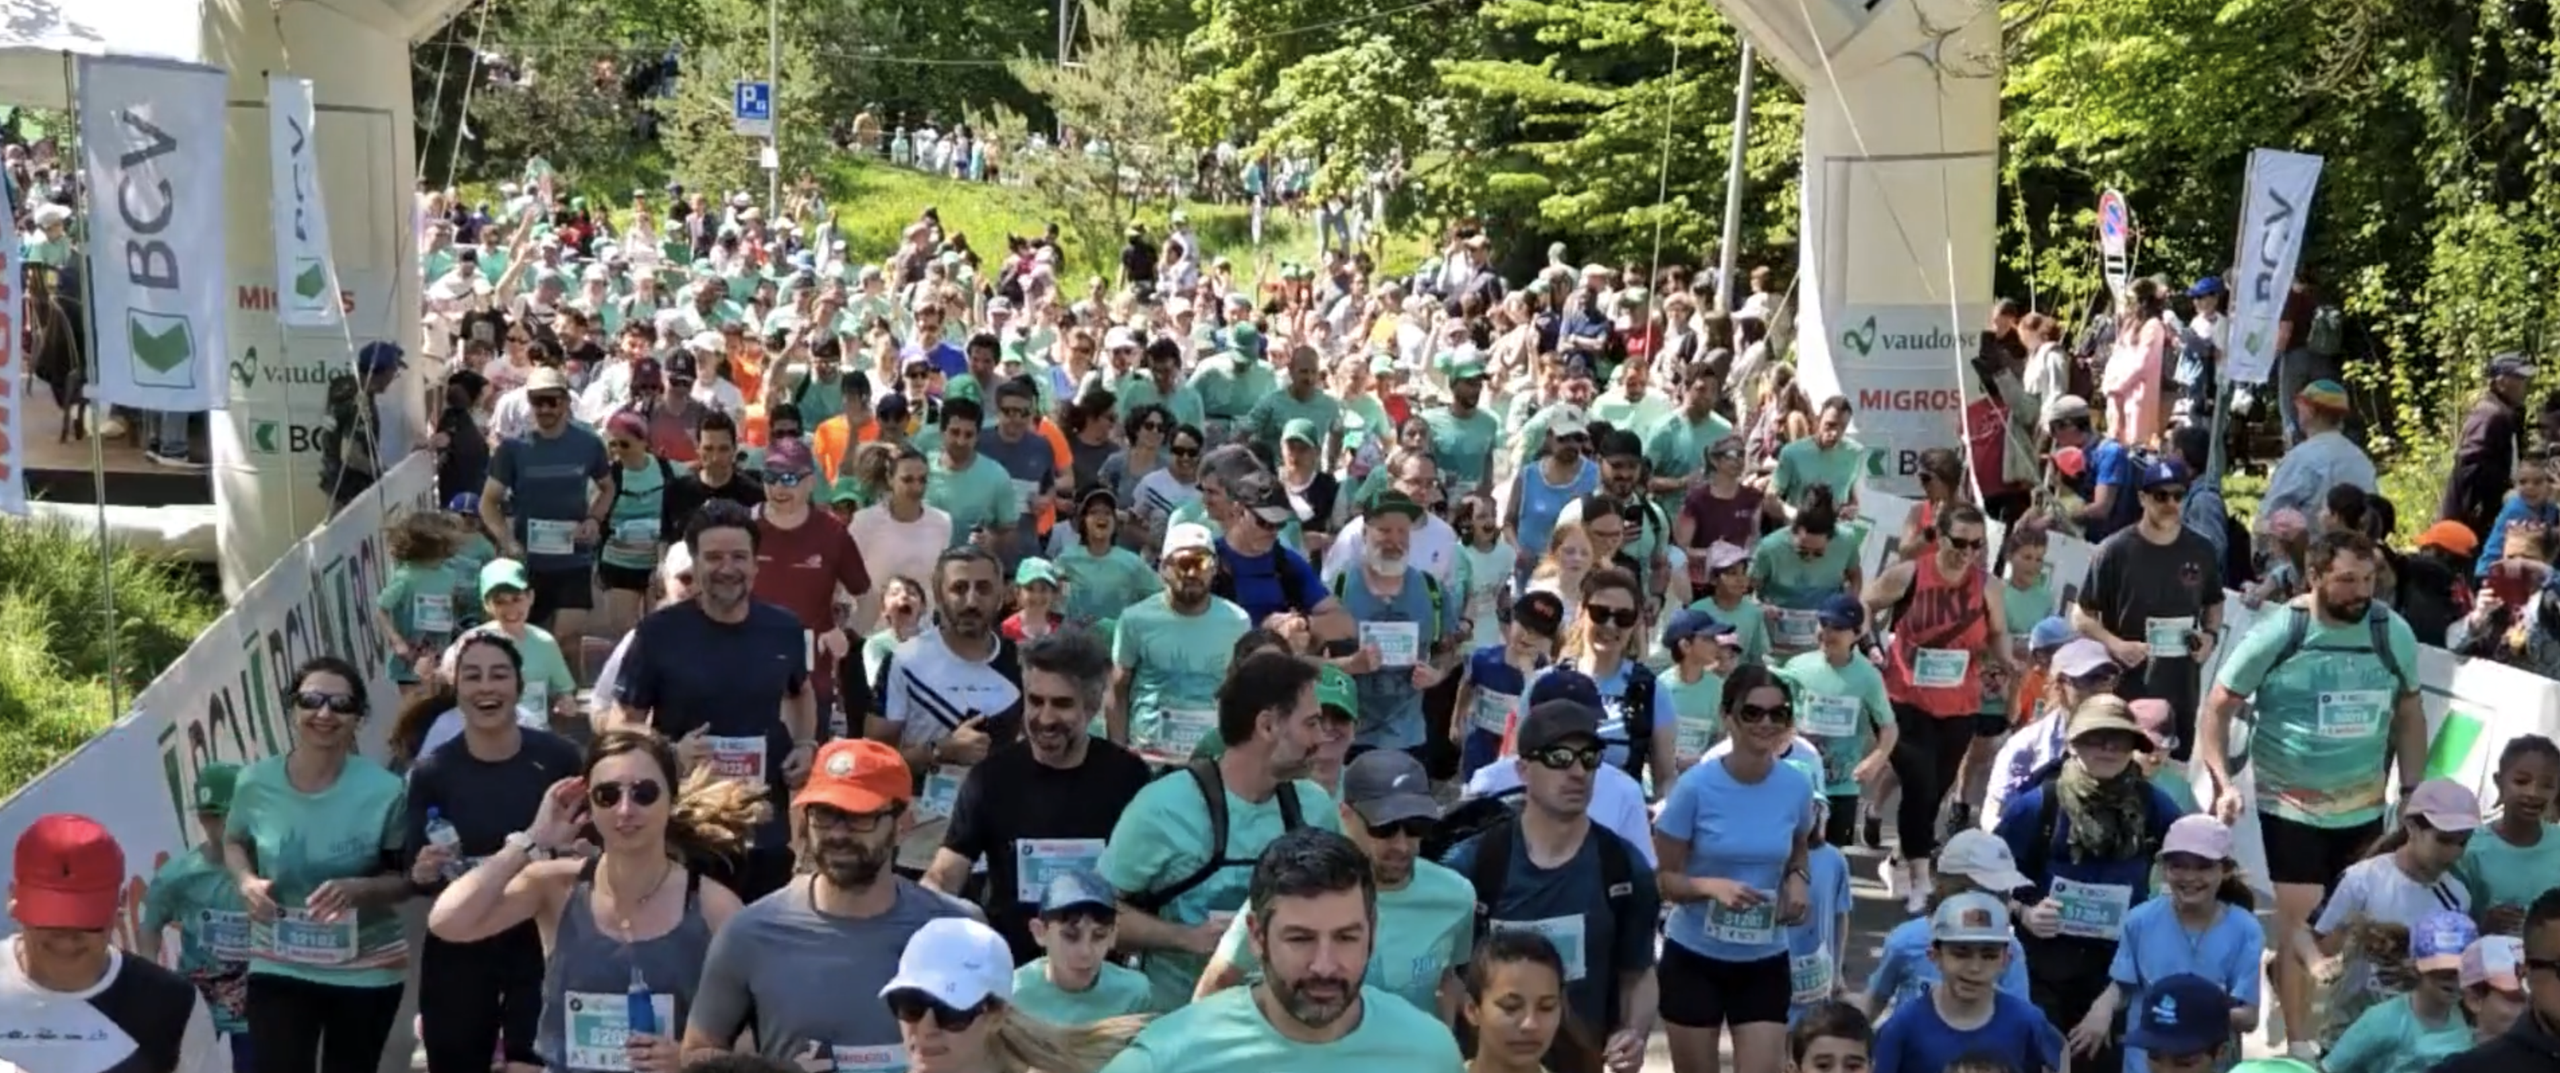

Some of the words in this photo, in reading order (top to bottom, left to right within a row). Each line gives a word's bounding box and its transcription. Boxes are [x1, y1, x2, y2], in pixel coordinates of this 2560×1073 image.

[117, 109, 180, 291] BCV
[238, 285, 356, 314] MIS
[1859, 389, 1961, 412] MIGROS
